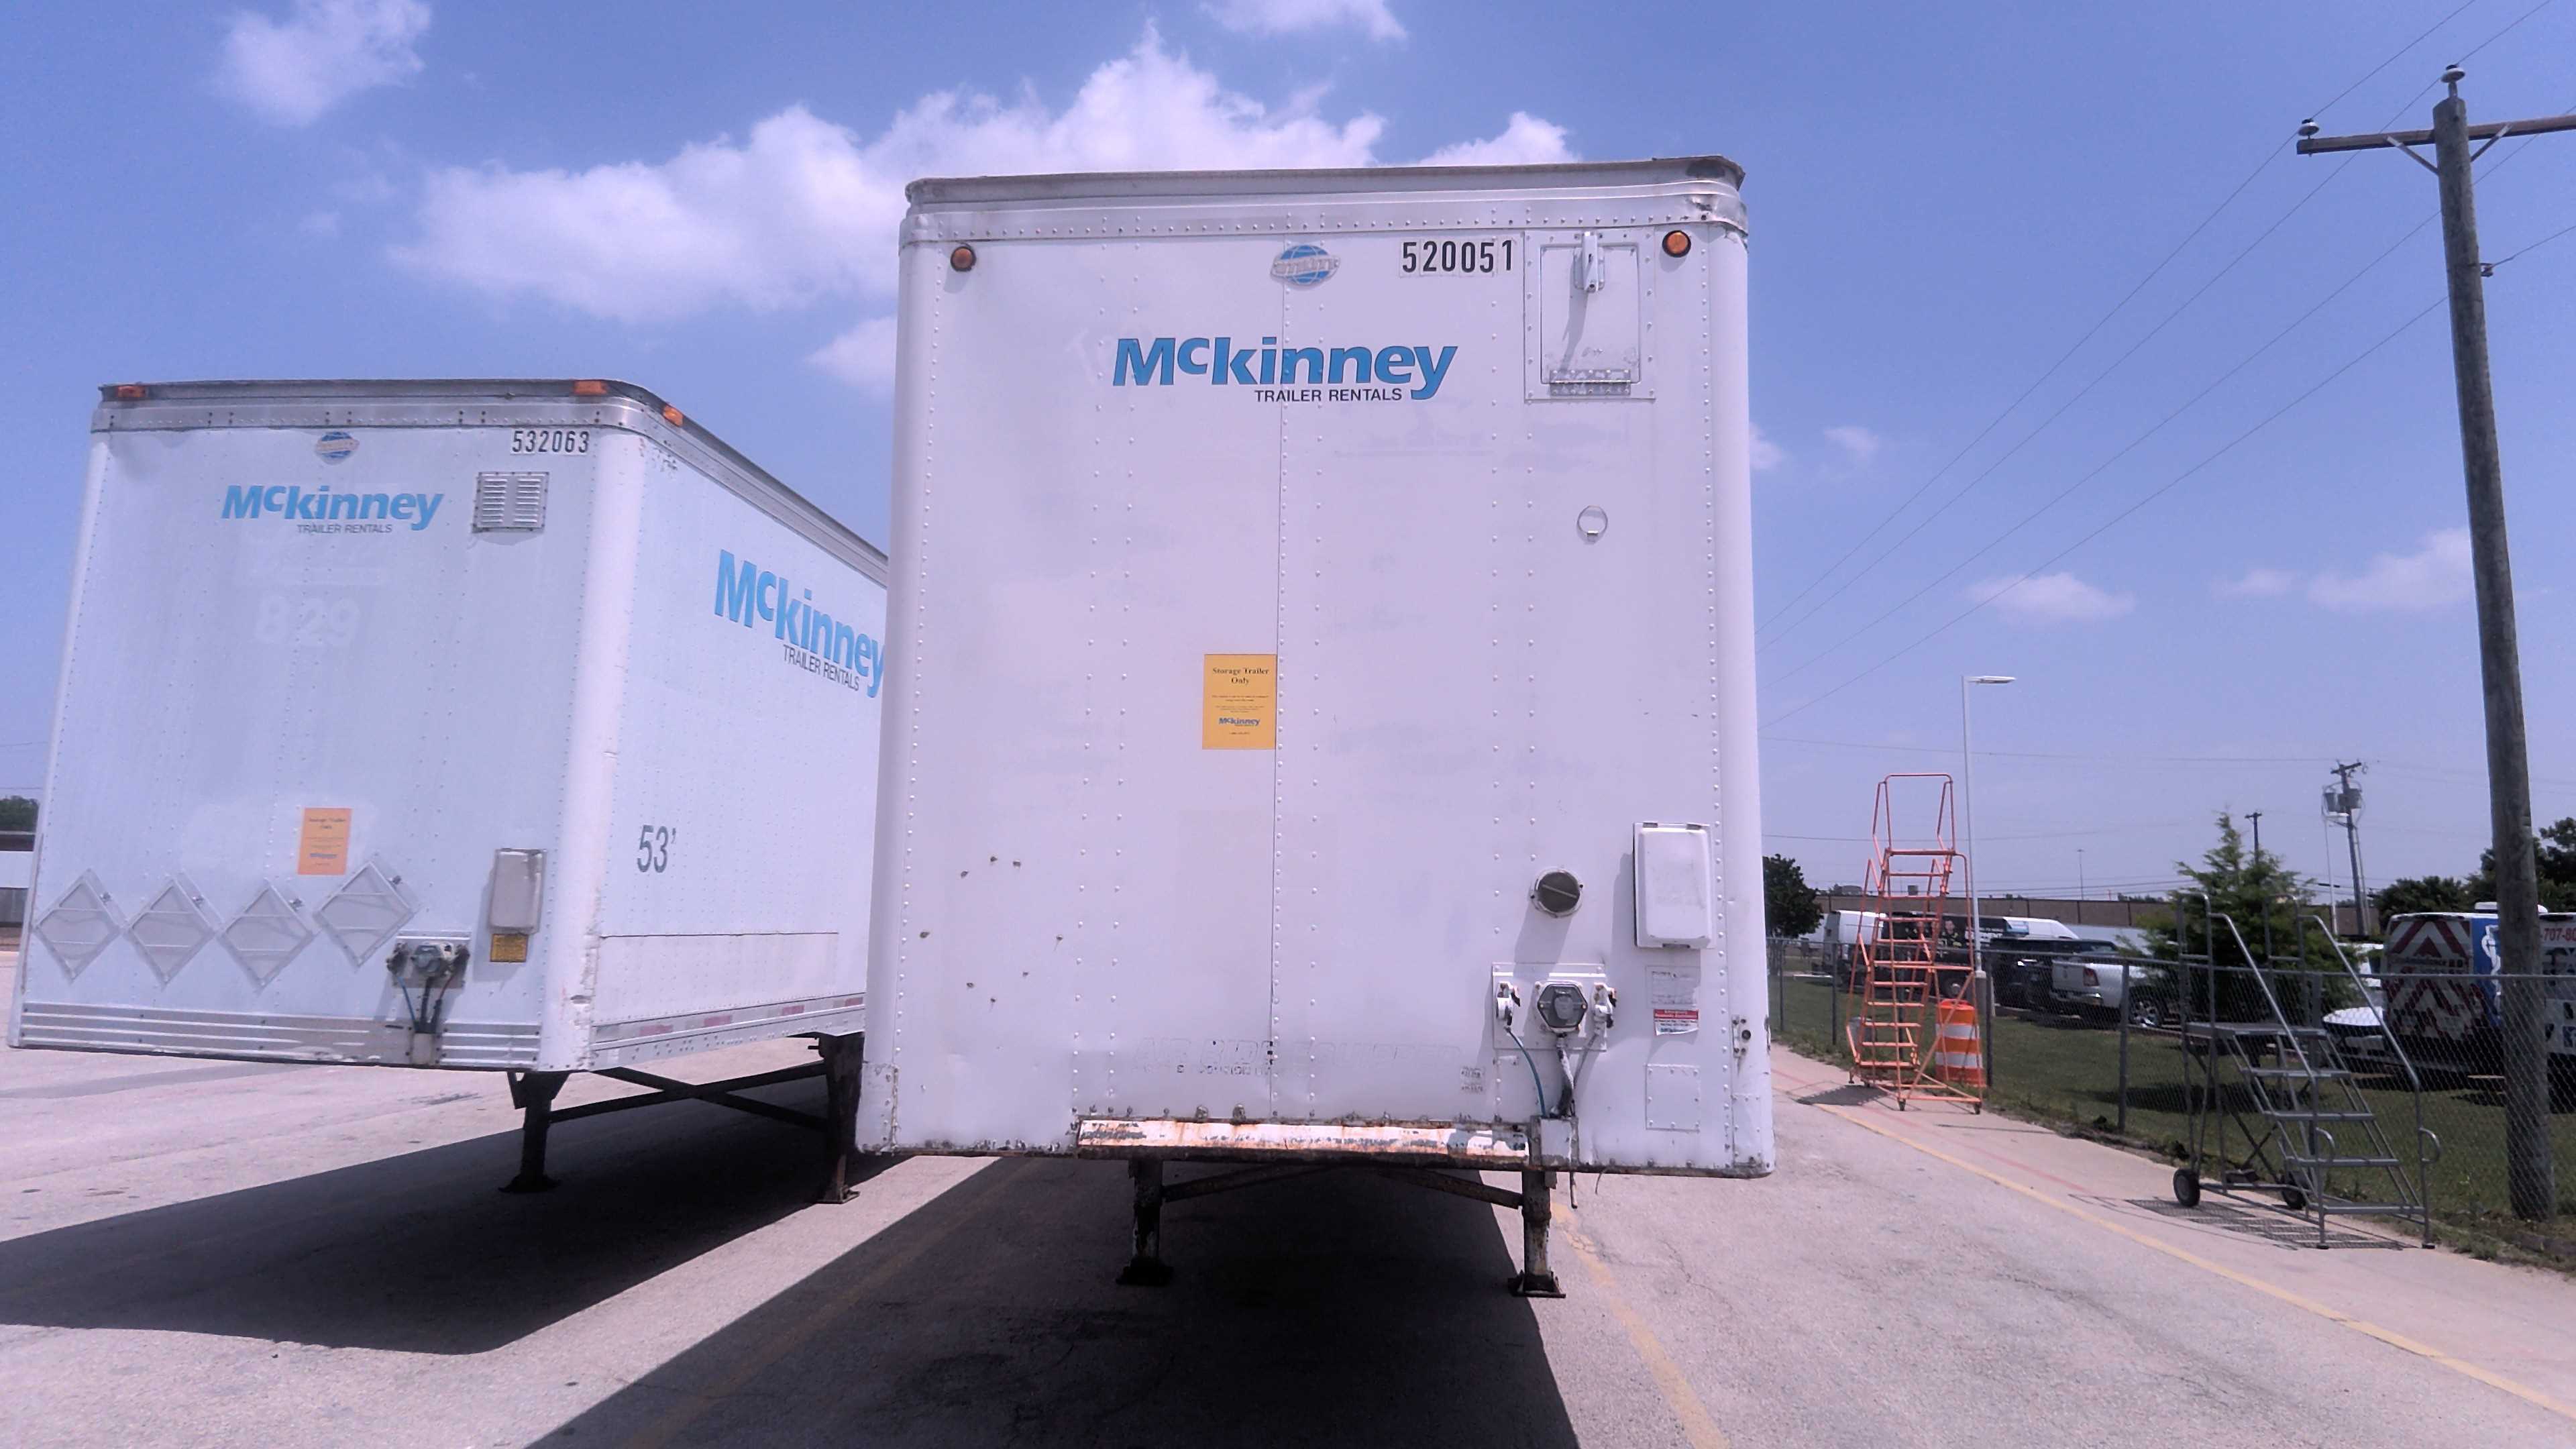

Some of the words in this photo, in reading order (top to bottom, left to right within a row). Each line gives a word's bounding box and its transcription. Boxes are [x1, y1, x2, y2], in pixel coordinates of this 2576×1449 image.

[1402, 239, 1512, 274] 520051
[1254, 389, 1322, 402] TRAILER
[1328, 388, 1402, 402] RENTALS
[512, 429, 590, 453] 532063
[297, 524, 341, 534] TRAILER
[344, 524, 392, 534] RENTALS
[784, 644, 821, 676] TRAILER
[823, 661, 860, 692] RENTALS
[1212, 667, 1240, 676] Storage
[1244, 667, 1269, 675] Trailer
[1231, 677, 1249, 685] Only
